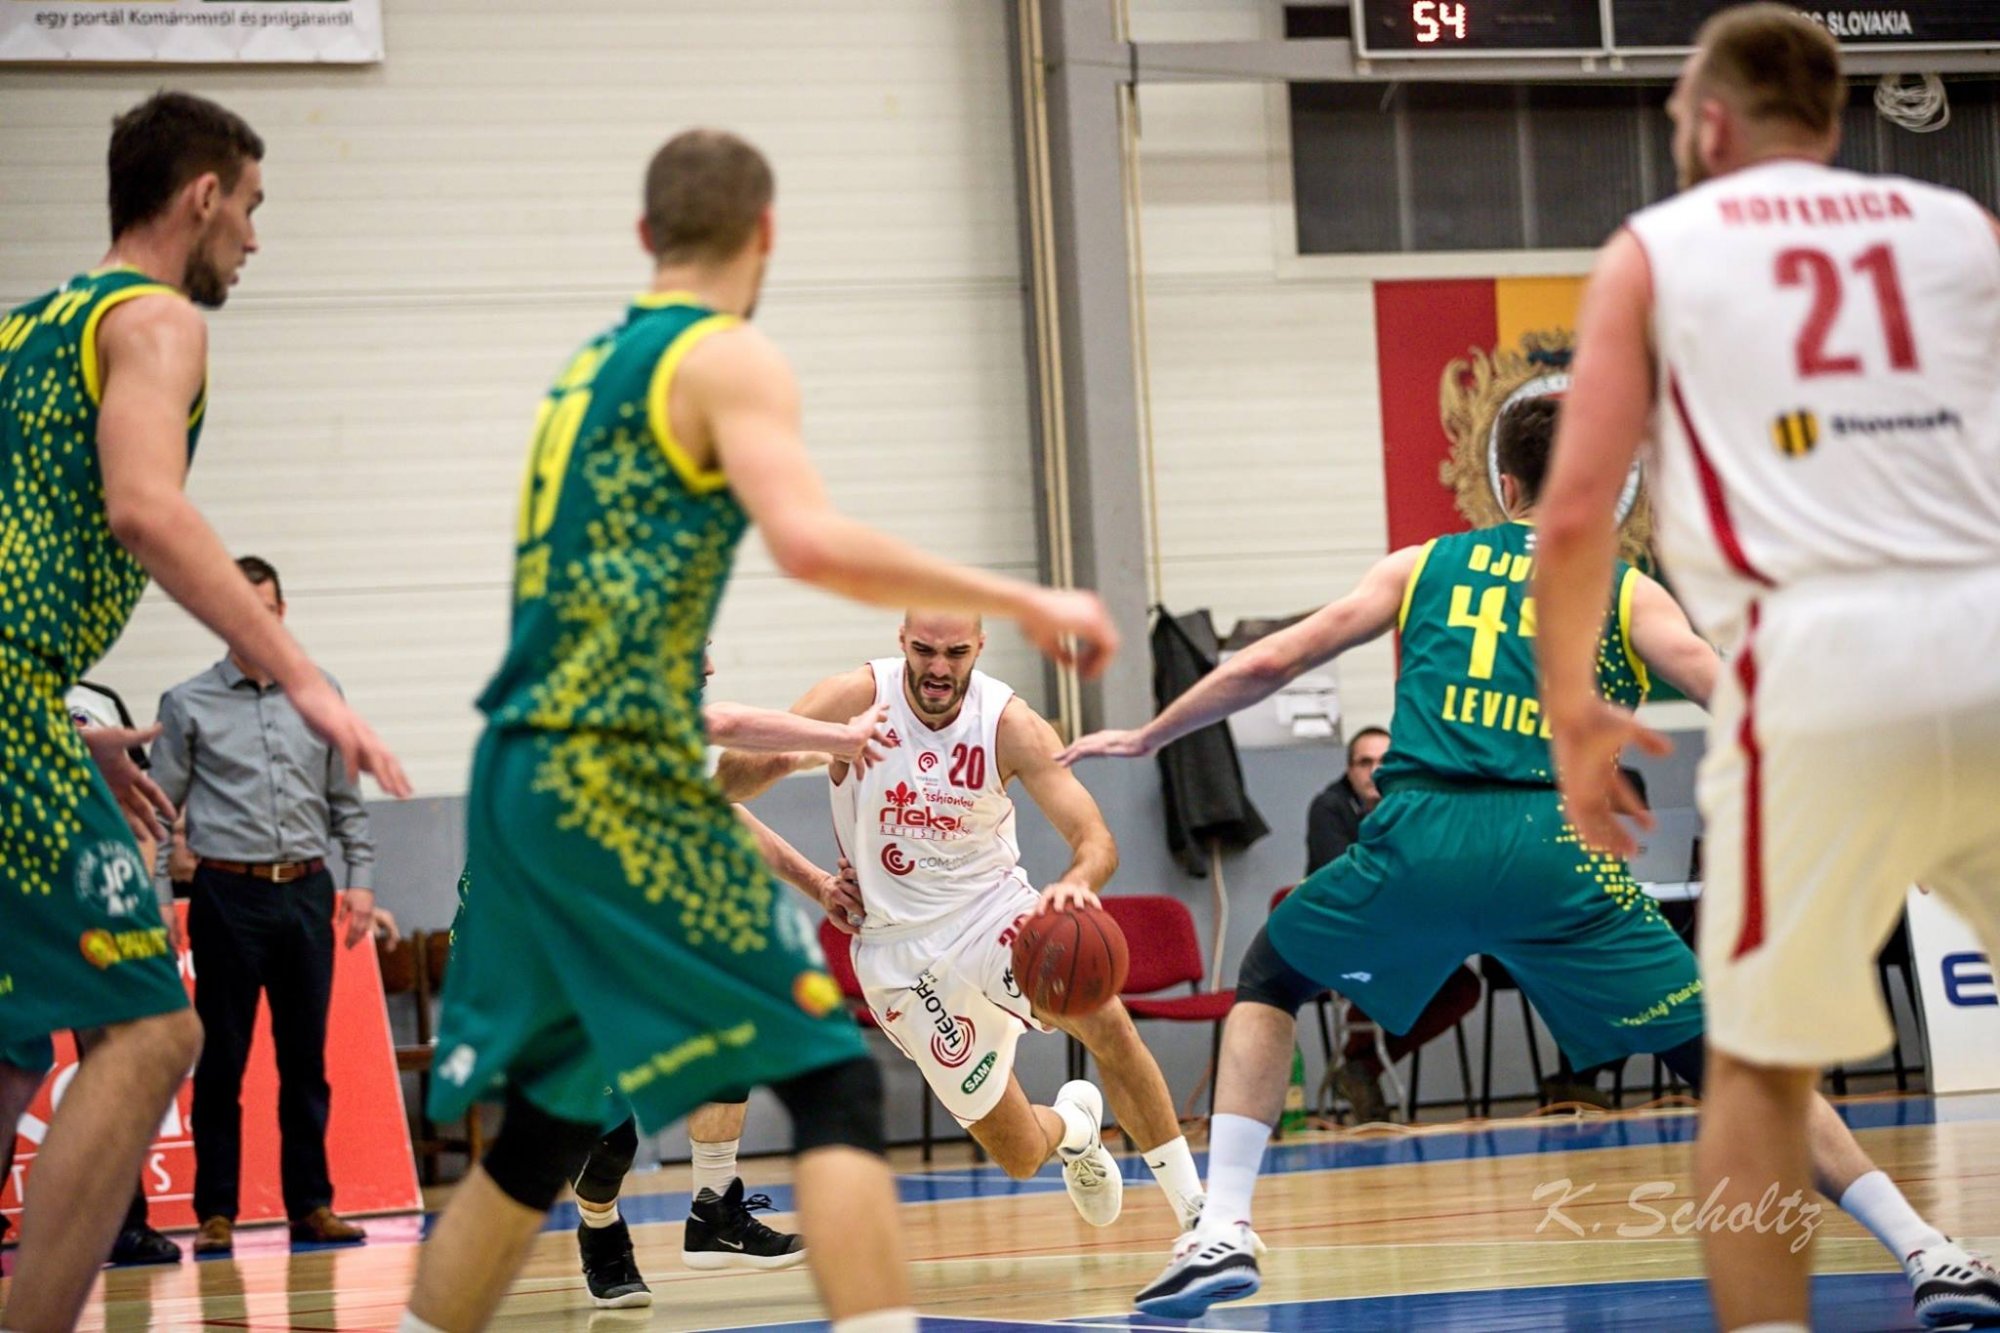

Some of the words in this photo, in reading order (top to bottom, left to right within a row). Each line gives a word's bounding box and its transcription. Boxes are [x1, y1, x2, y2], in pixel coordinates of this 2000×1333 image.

[34, 10, 66, 29] egy
[72, 9, 124, 29] portál
[1412, 0, 1467, 43] 54
[1826, 11, 1913, 36] SLOVAKIA
[1772, 242, 1921, 380] 21
[948, 742, 986, 790] 20
